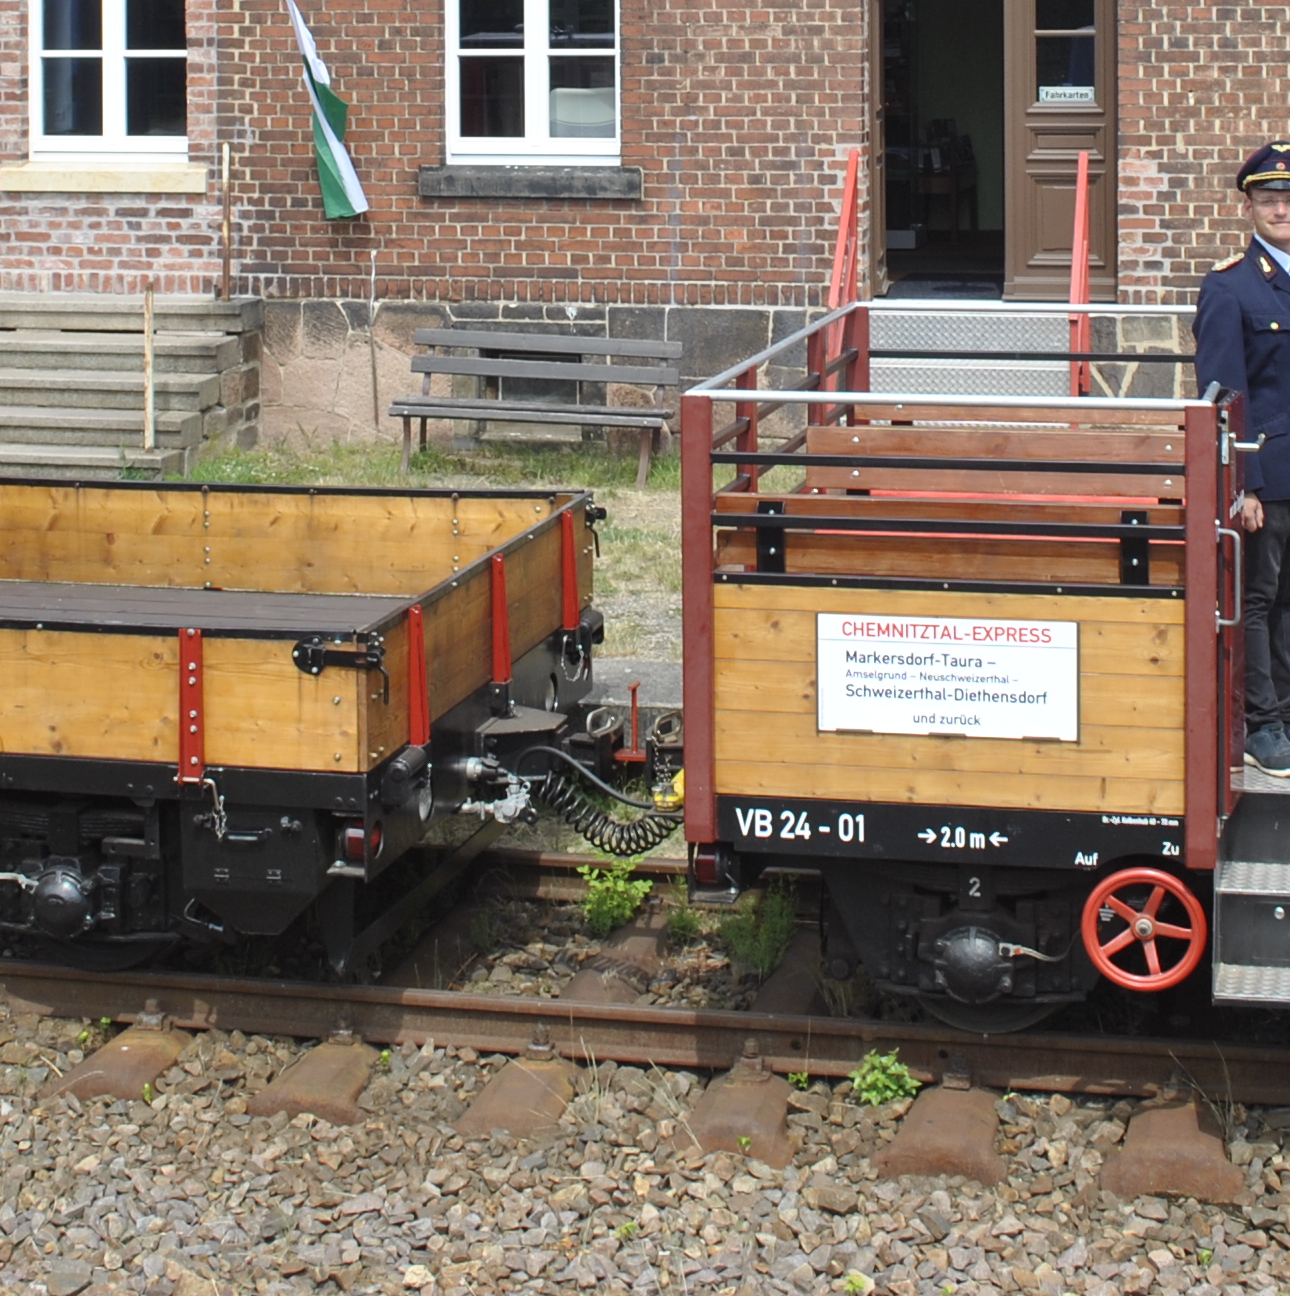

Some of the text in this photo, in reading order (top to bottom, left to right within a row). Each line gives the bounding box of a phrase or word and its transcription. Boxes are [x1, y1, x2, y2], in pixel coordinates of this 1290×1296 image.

[841, 621, 1052, 643] CHEMNITZTAL-EXPRESS
[845, 650, 983, 668] Markersdorf-Taura
[845, 669, 907, 681] Amselgrund
[919, 672, 1009, 684] Neuschweizerthal
[845, 684, 1047, 704] Schweizerthal-Diethensdorf
[913, 713, 981, 726] und zurück
[735, 807, 773, 838] VB
[779, 810, 811, 840] 24
[838, 813, 865, 843] 01
[940, 826, 986, 849] 2.0 m
[1162, 841, 1180, 856] Zu
[1074, 851, 1098, 866] Auf
[968, 877, 981, 897] 2
